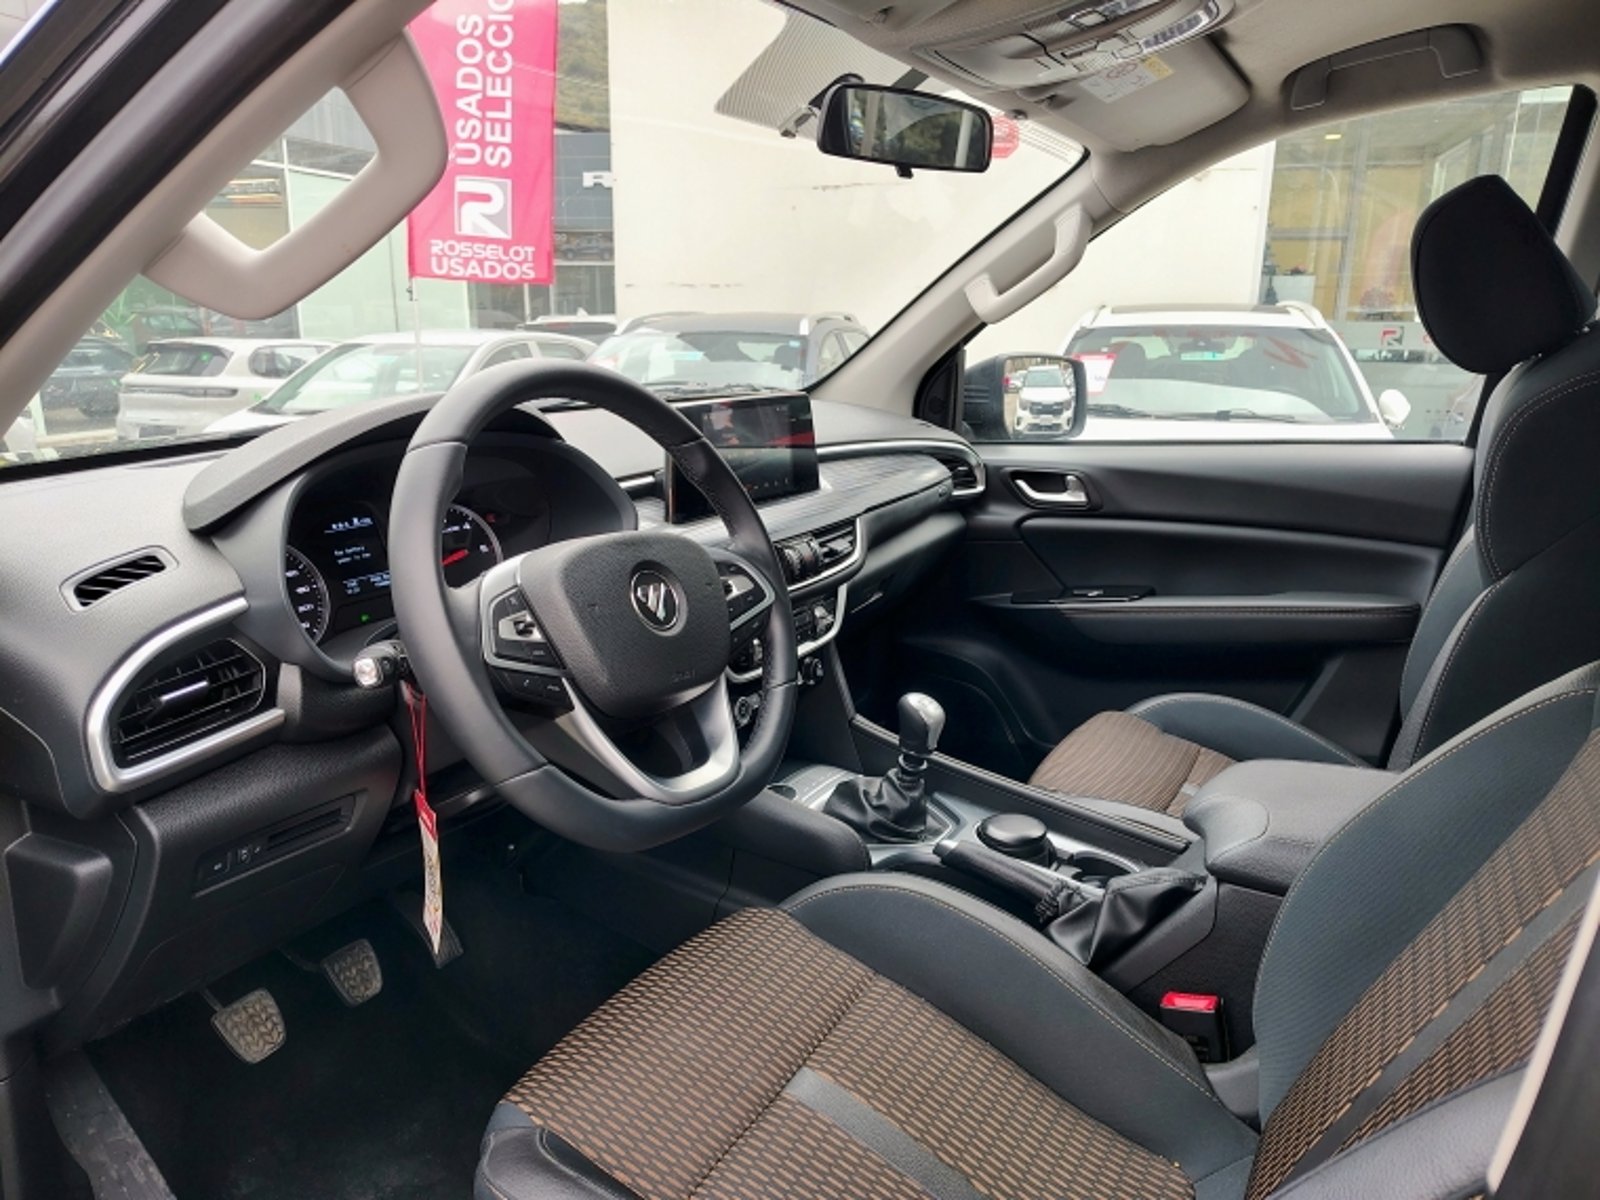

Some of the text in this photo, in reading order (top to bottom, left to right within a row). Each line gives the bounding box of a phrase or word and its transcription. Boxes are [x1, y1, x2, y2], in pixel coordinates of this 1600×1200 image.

[456, 14, 483, 165] USADOS
[430, 239, 536, 262] ROSSELOT
[431, 256, 536, 280] USADOS
